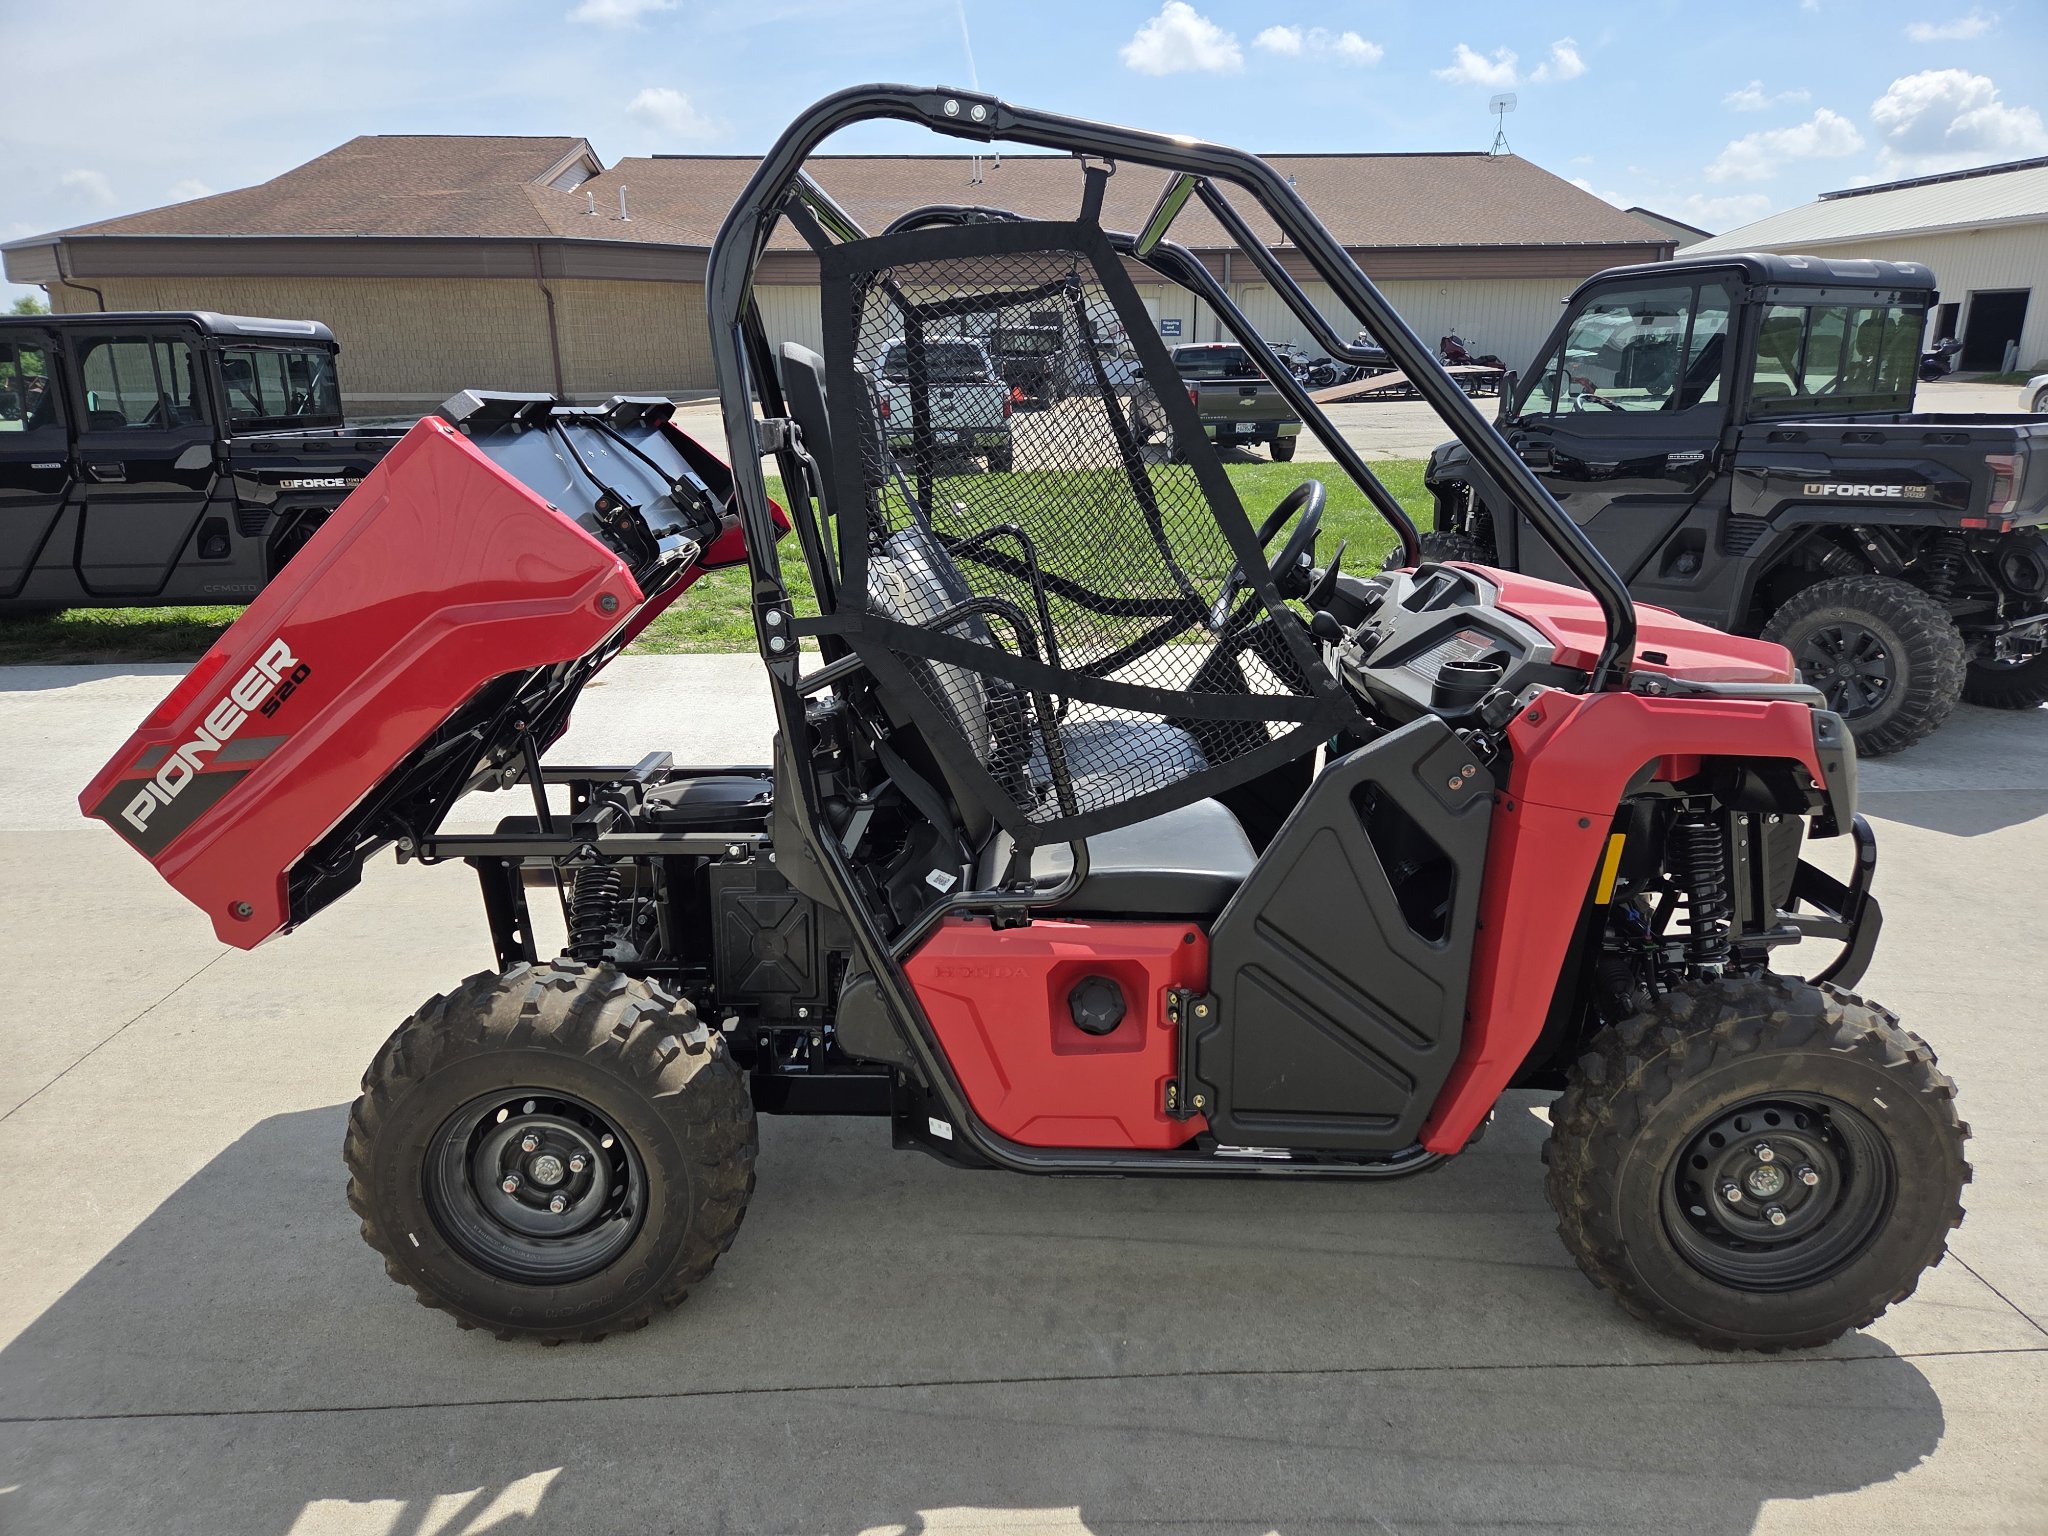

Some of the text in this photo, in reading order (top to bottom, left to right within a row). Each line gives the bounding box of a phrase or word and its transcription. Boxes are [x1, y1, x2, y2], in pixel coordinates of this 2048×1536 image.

[1804, 484, 1903, 497] UFORCE
[204, 584, 257, 592] CFMOTO
[259, 663, 312, 719] 520
[121, 637, 299, 833] PIONEER
[935, 966, 1031, 977] HONDA
